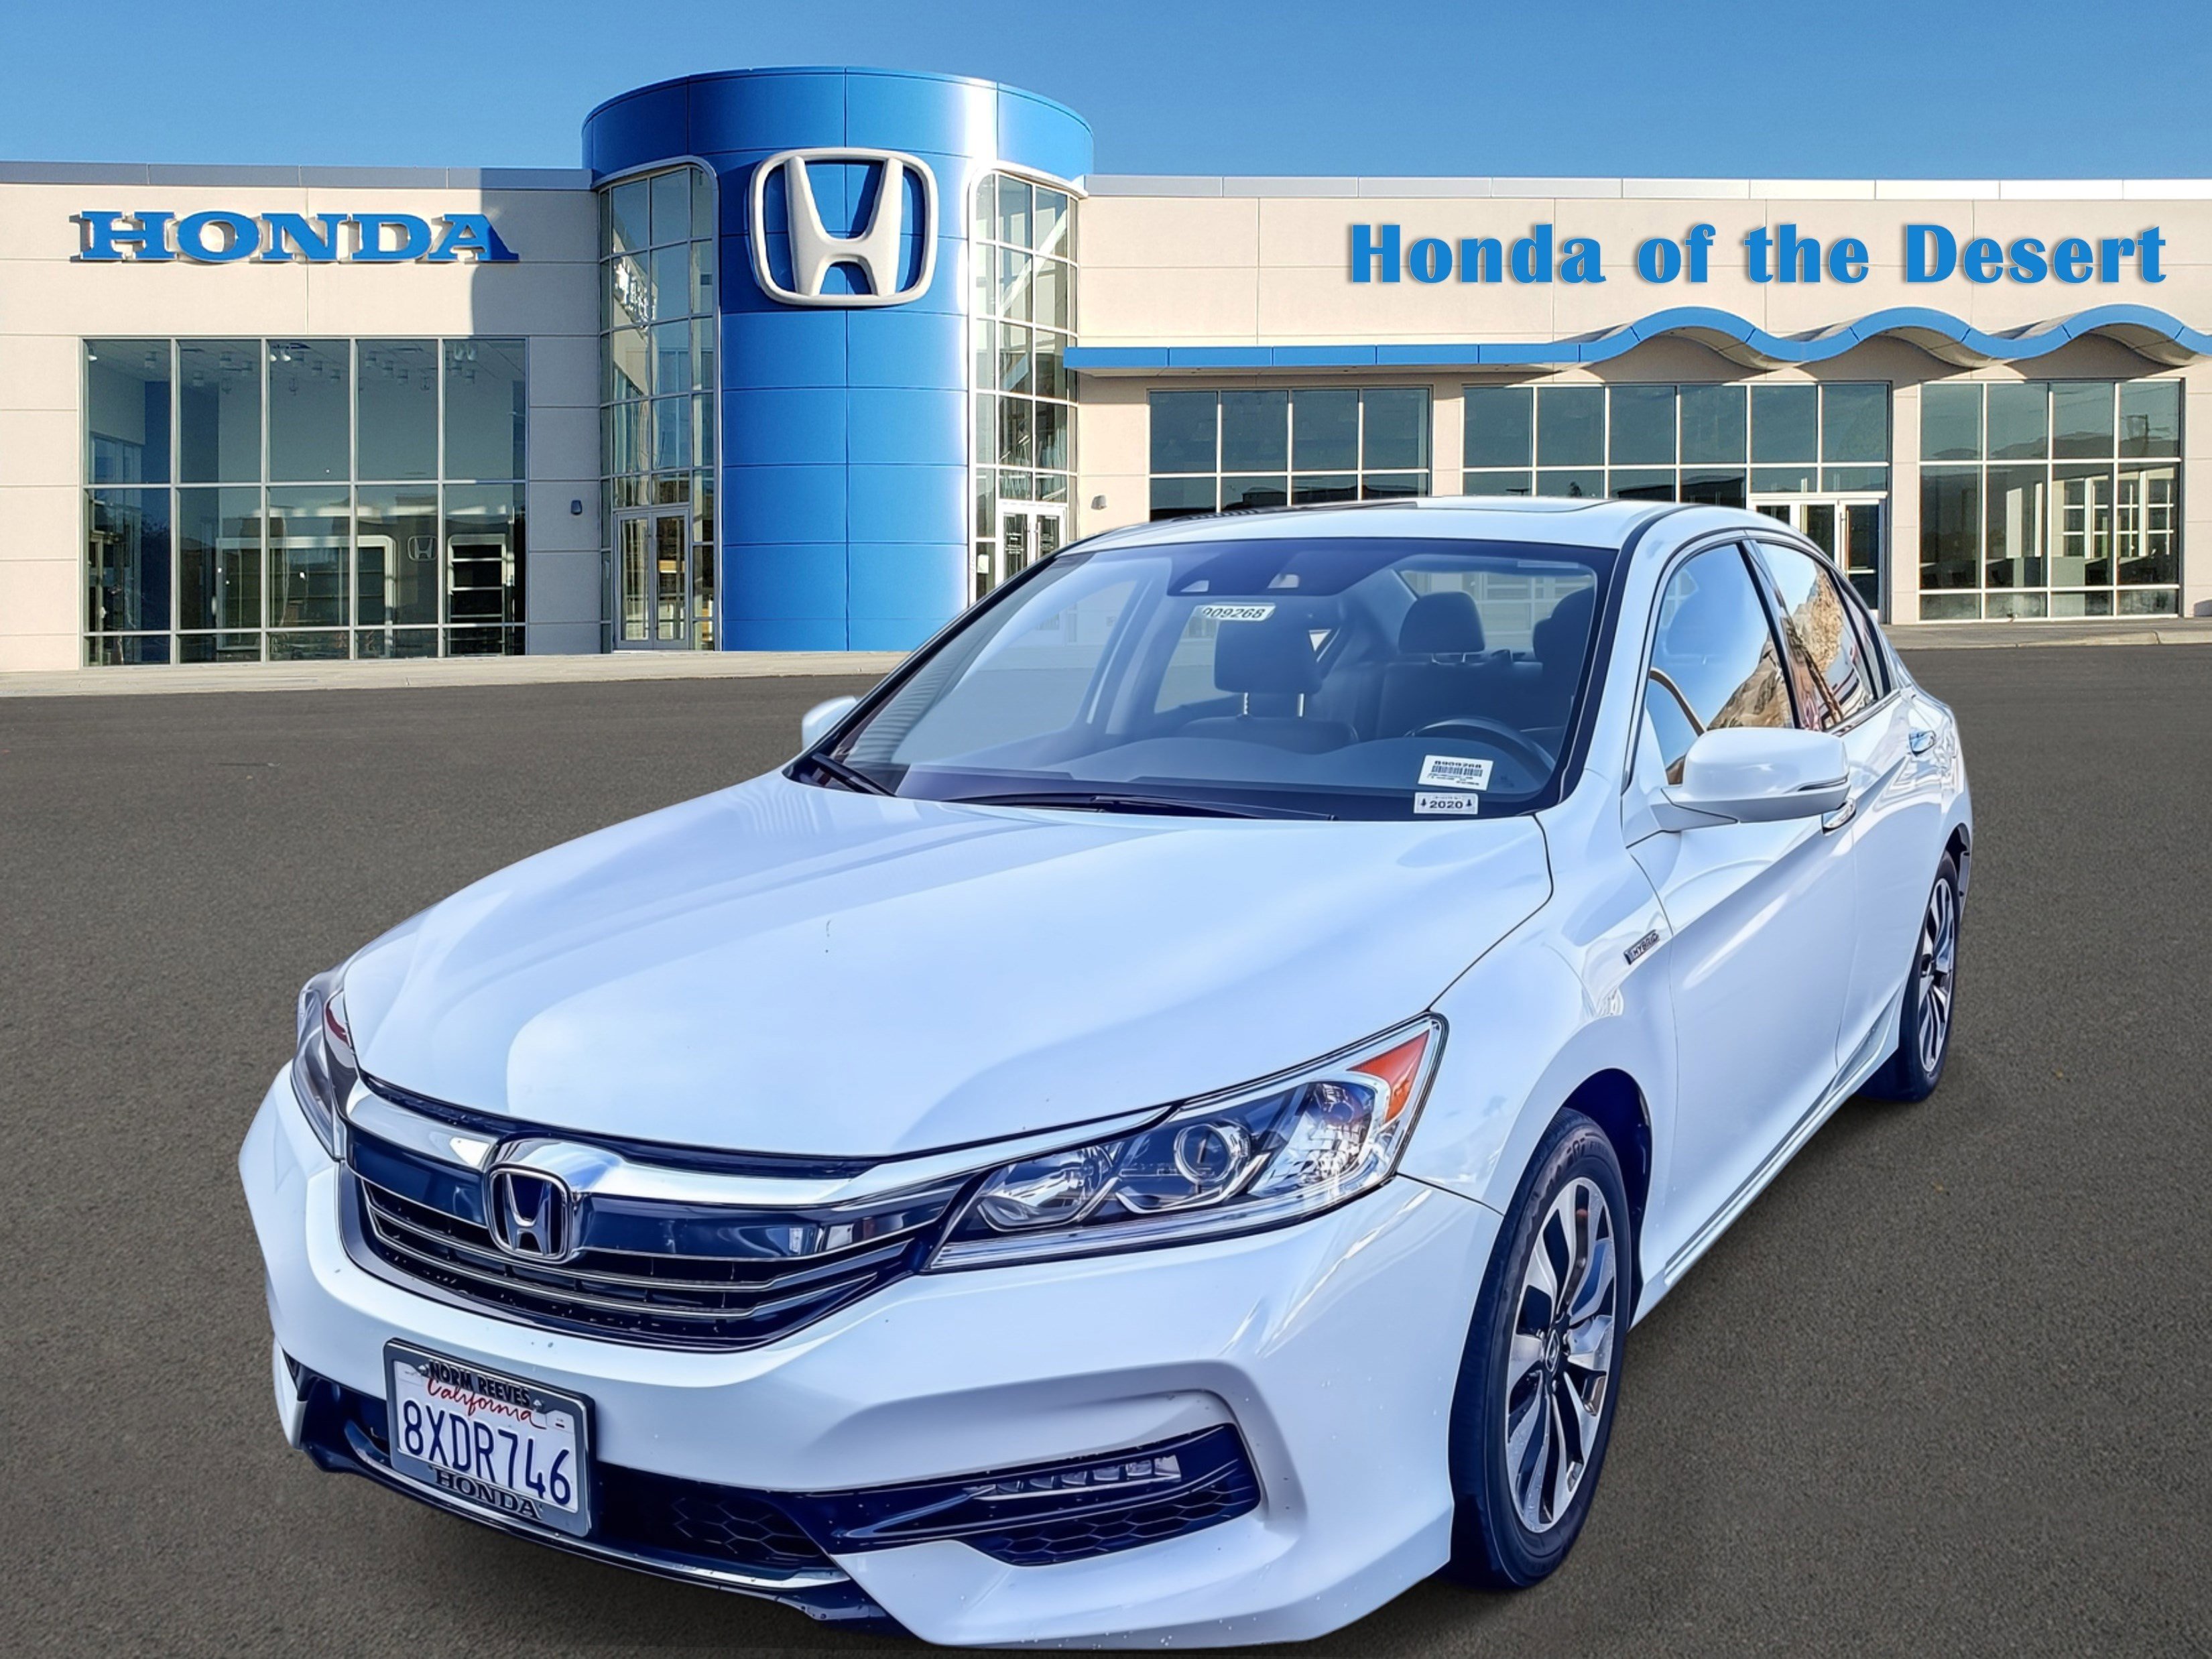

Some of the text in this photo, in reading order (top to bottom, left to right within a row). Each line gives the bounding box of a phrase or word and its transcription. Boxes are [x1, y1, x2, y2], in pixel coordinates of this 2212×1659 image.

[80, 211, 519, 262] HONDA
[1351, 223, 2166, 284] Honda of the Desert
[1428, 799, 1464, 809] 2020
[427, 1377, 547, 1430] California
[428, 1360, 531, 1408] NORM REEVES
[403, 1399, 571, 1506] 8XDR746
[436, 1470, 542, 1520] HONDA
